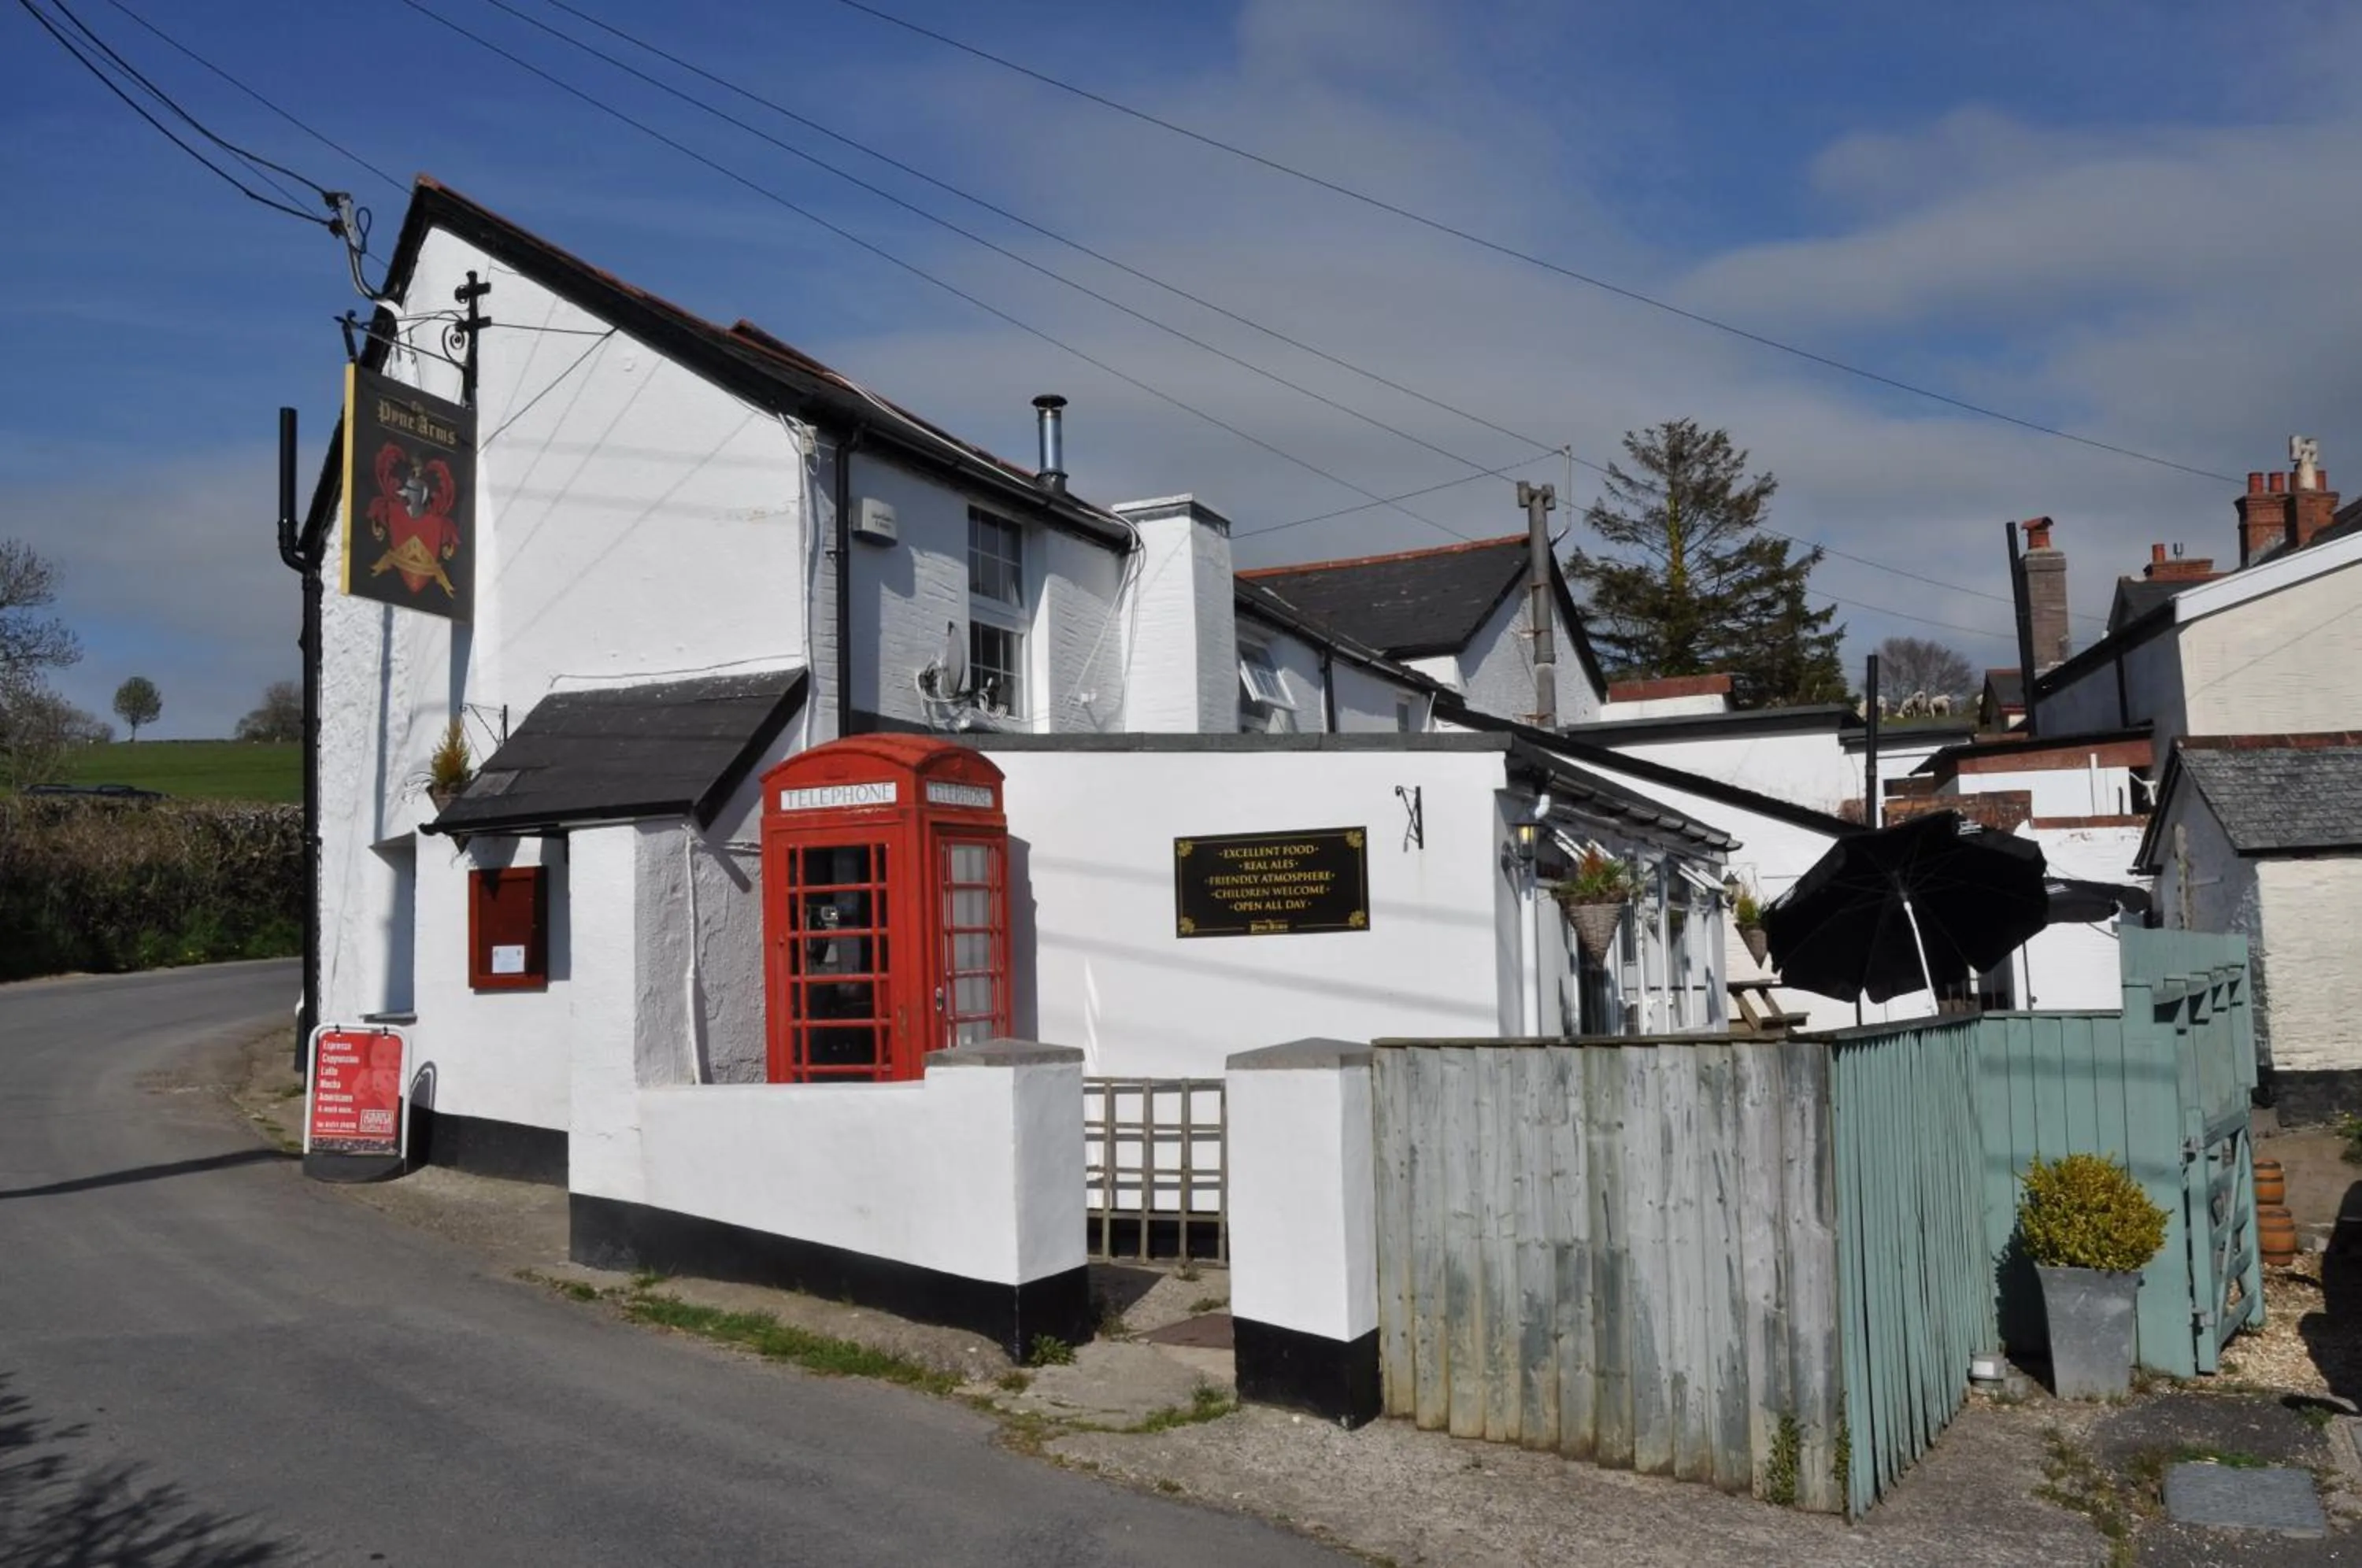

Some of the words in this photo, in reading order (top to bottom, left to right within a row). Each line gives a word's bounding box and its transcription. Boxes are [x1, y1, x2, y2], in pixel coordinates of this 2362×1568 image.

[417, 415, 457, 446] Arms
[787, 783, 894, 808] TELEPHONE
[929, 782, 991, 806] TELEPHONE
[1224, 846, 1279, 858] EXCELLENT
[1283, 845, 1314, 856] FOOD
[1244, 860, 1268, 871] REAL
[1271, 859, 1294, 869] ALES
[1209, 875, 1259, 886] FRIENDLY
[1261, 871, 1331, 882] ATMOSPHERE
[1215, 887, 1270, 899] CHILDREN
[1272, 884, 1325, 896] WELCOME
[1234, 900, 1262, 911] OPEN
[1265, 899, 1283, 910] ALL
[1286, 898, 1306, 909] DAY
